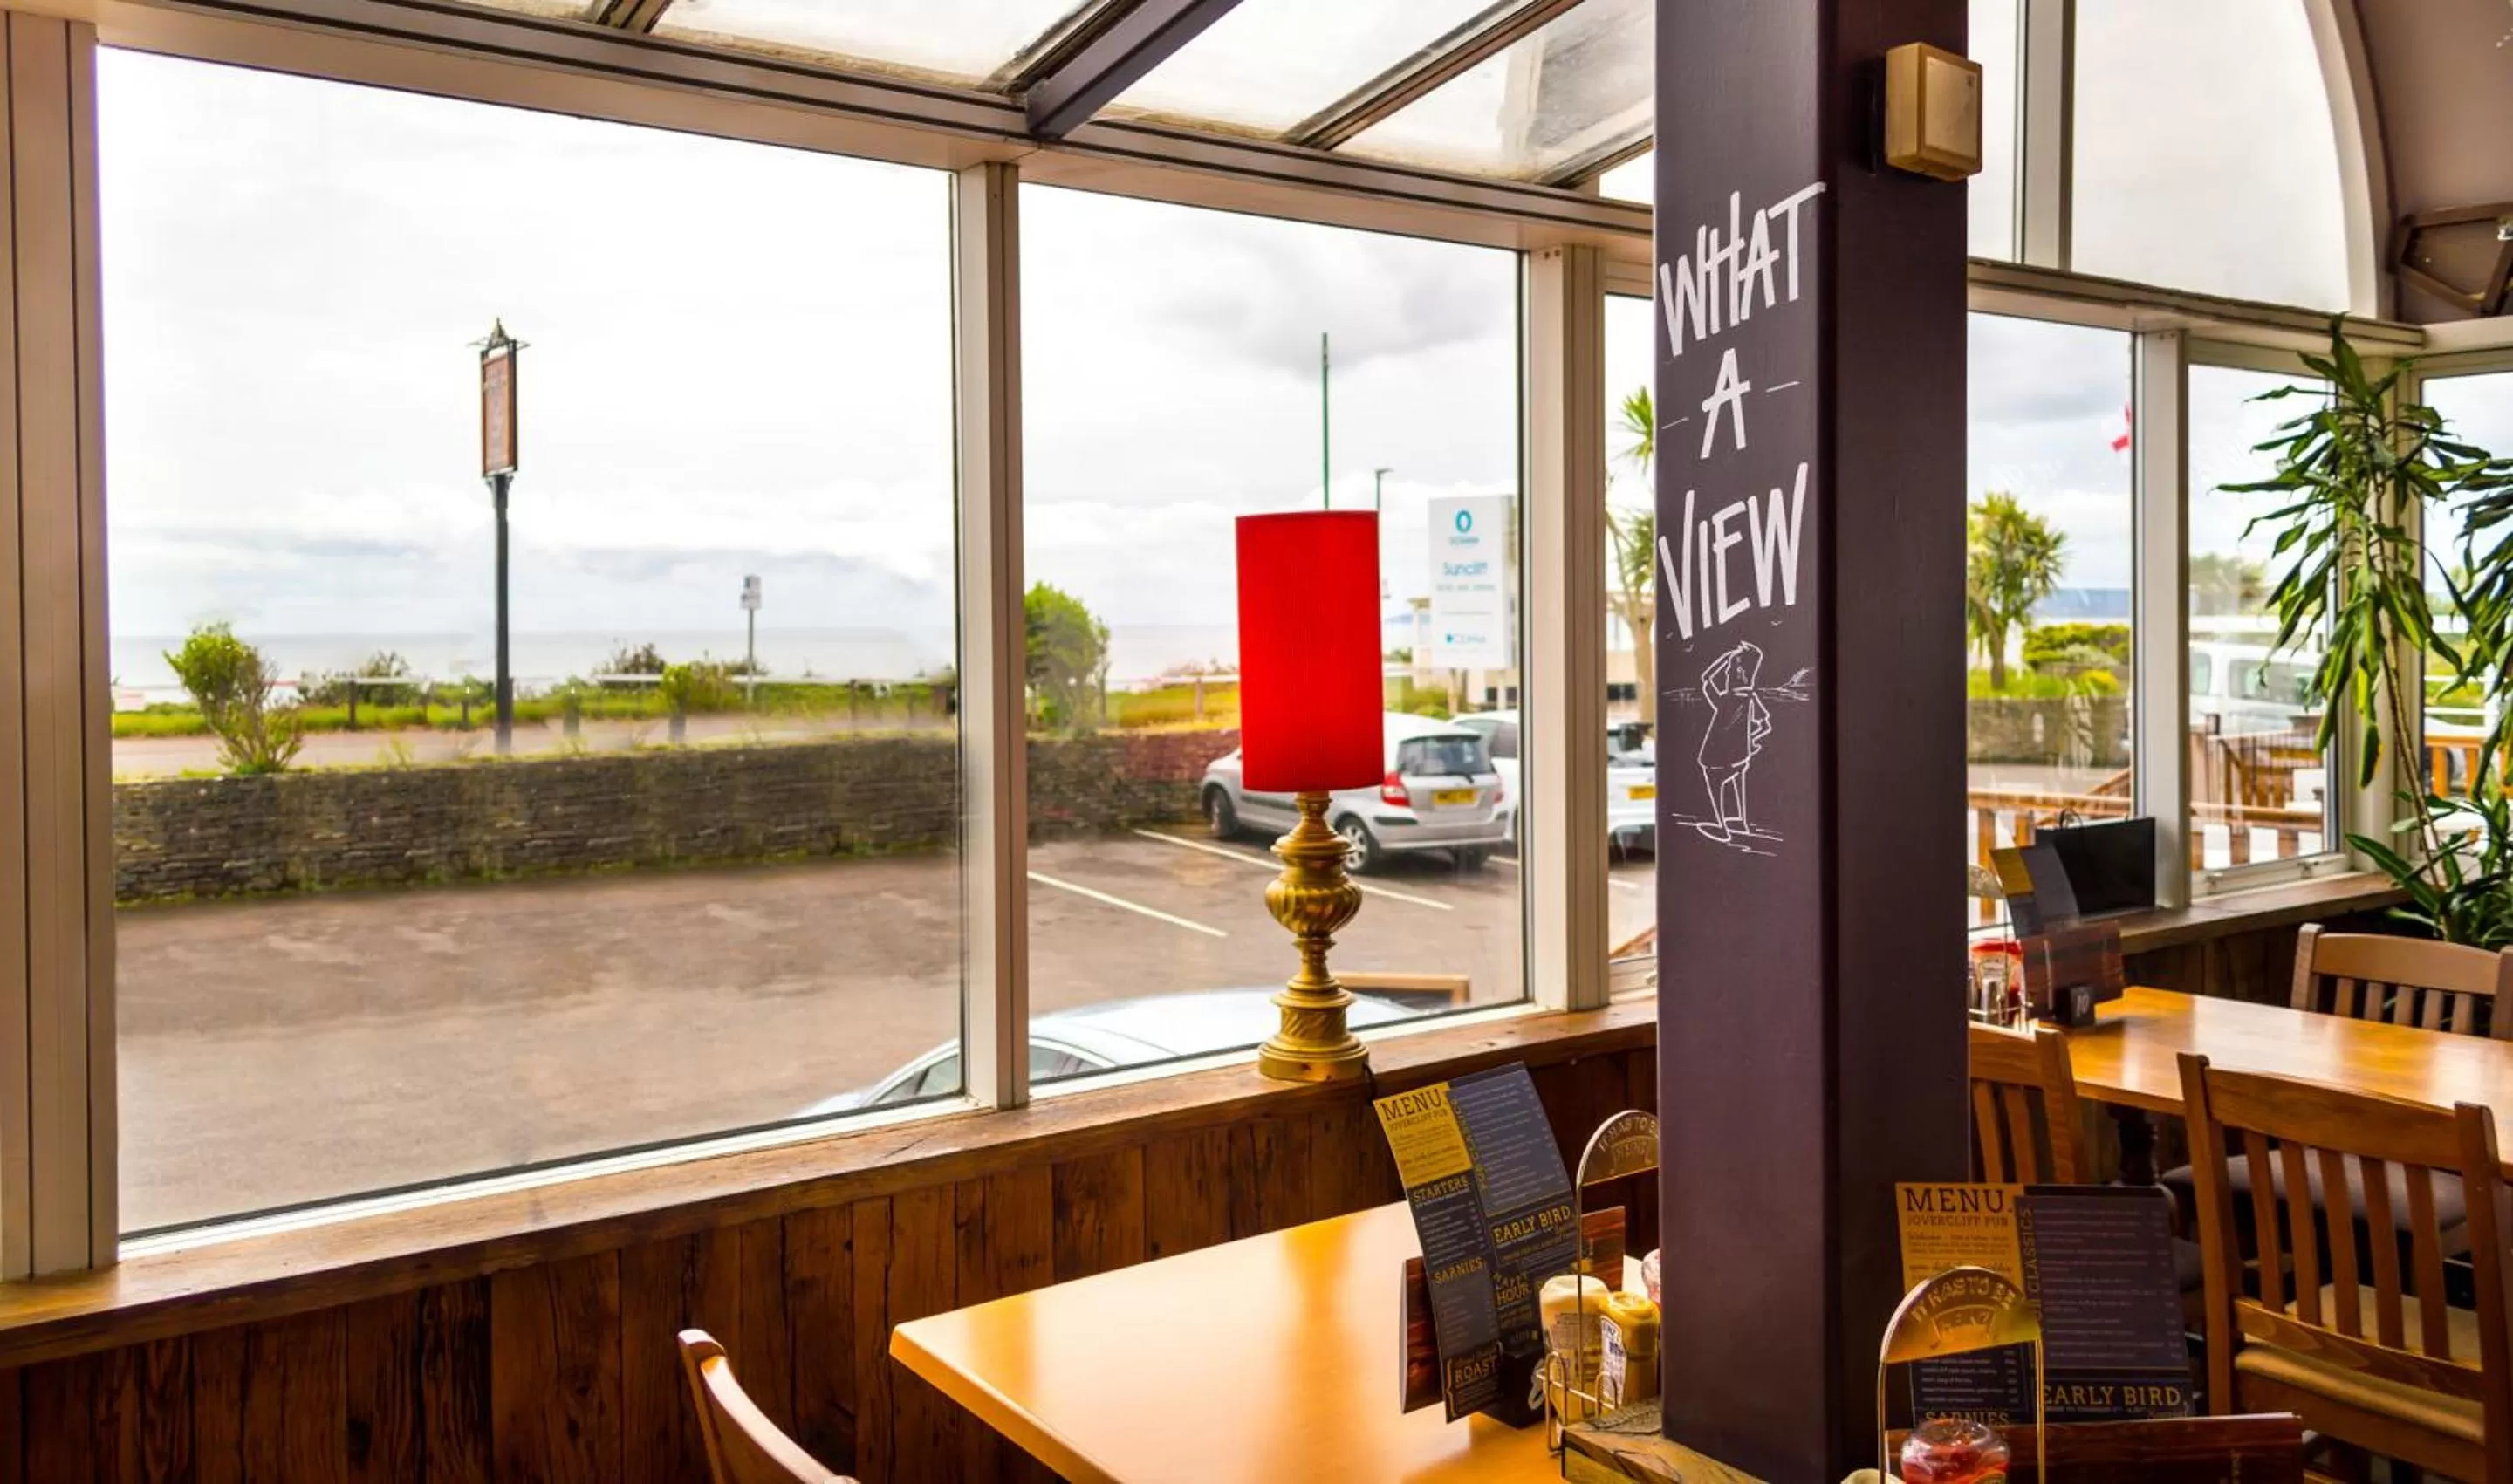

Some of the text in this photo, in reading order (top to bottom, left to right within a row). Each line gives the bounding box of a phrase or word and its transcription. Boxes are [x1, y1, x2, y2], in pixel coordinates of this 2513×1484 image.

[1660, 181, 1825, 356] WHAT
[1701, 348, 1750, 459] A
[1659, 462, 1809, 639] VIEW
[1413, 1175, 1469, 1202] STARTERS
[1493, 1216, 1535, 1243] EARLY
[1539, 1205, 1571, 1228] BIRD
[2044, 1385, 2181, 1406] EARLY BIRD
